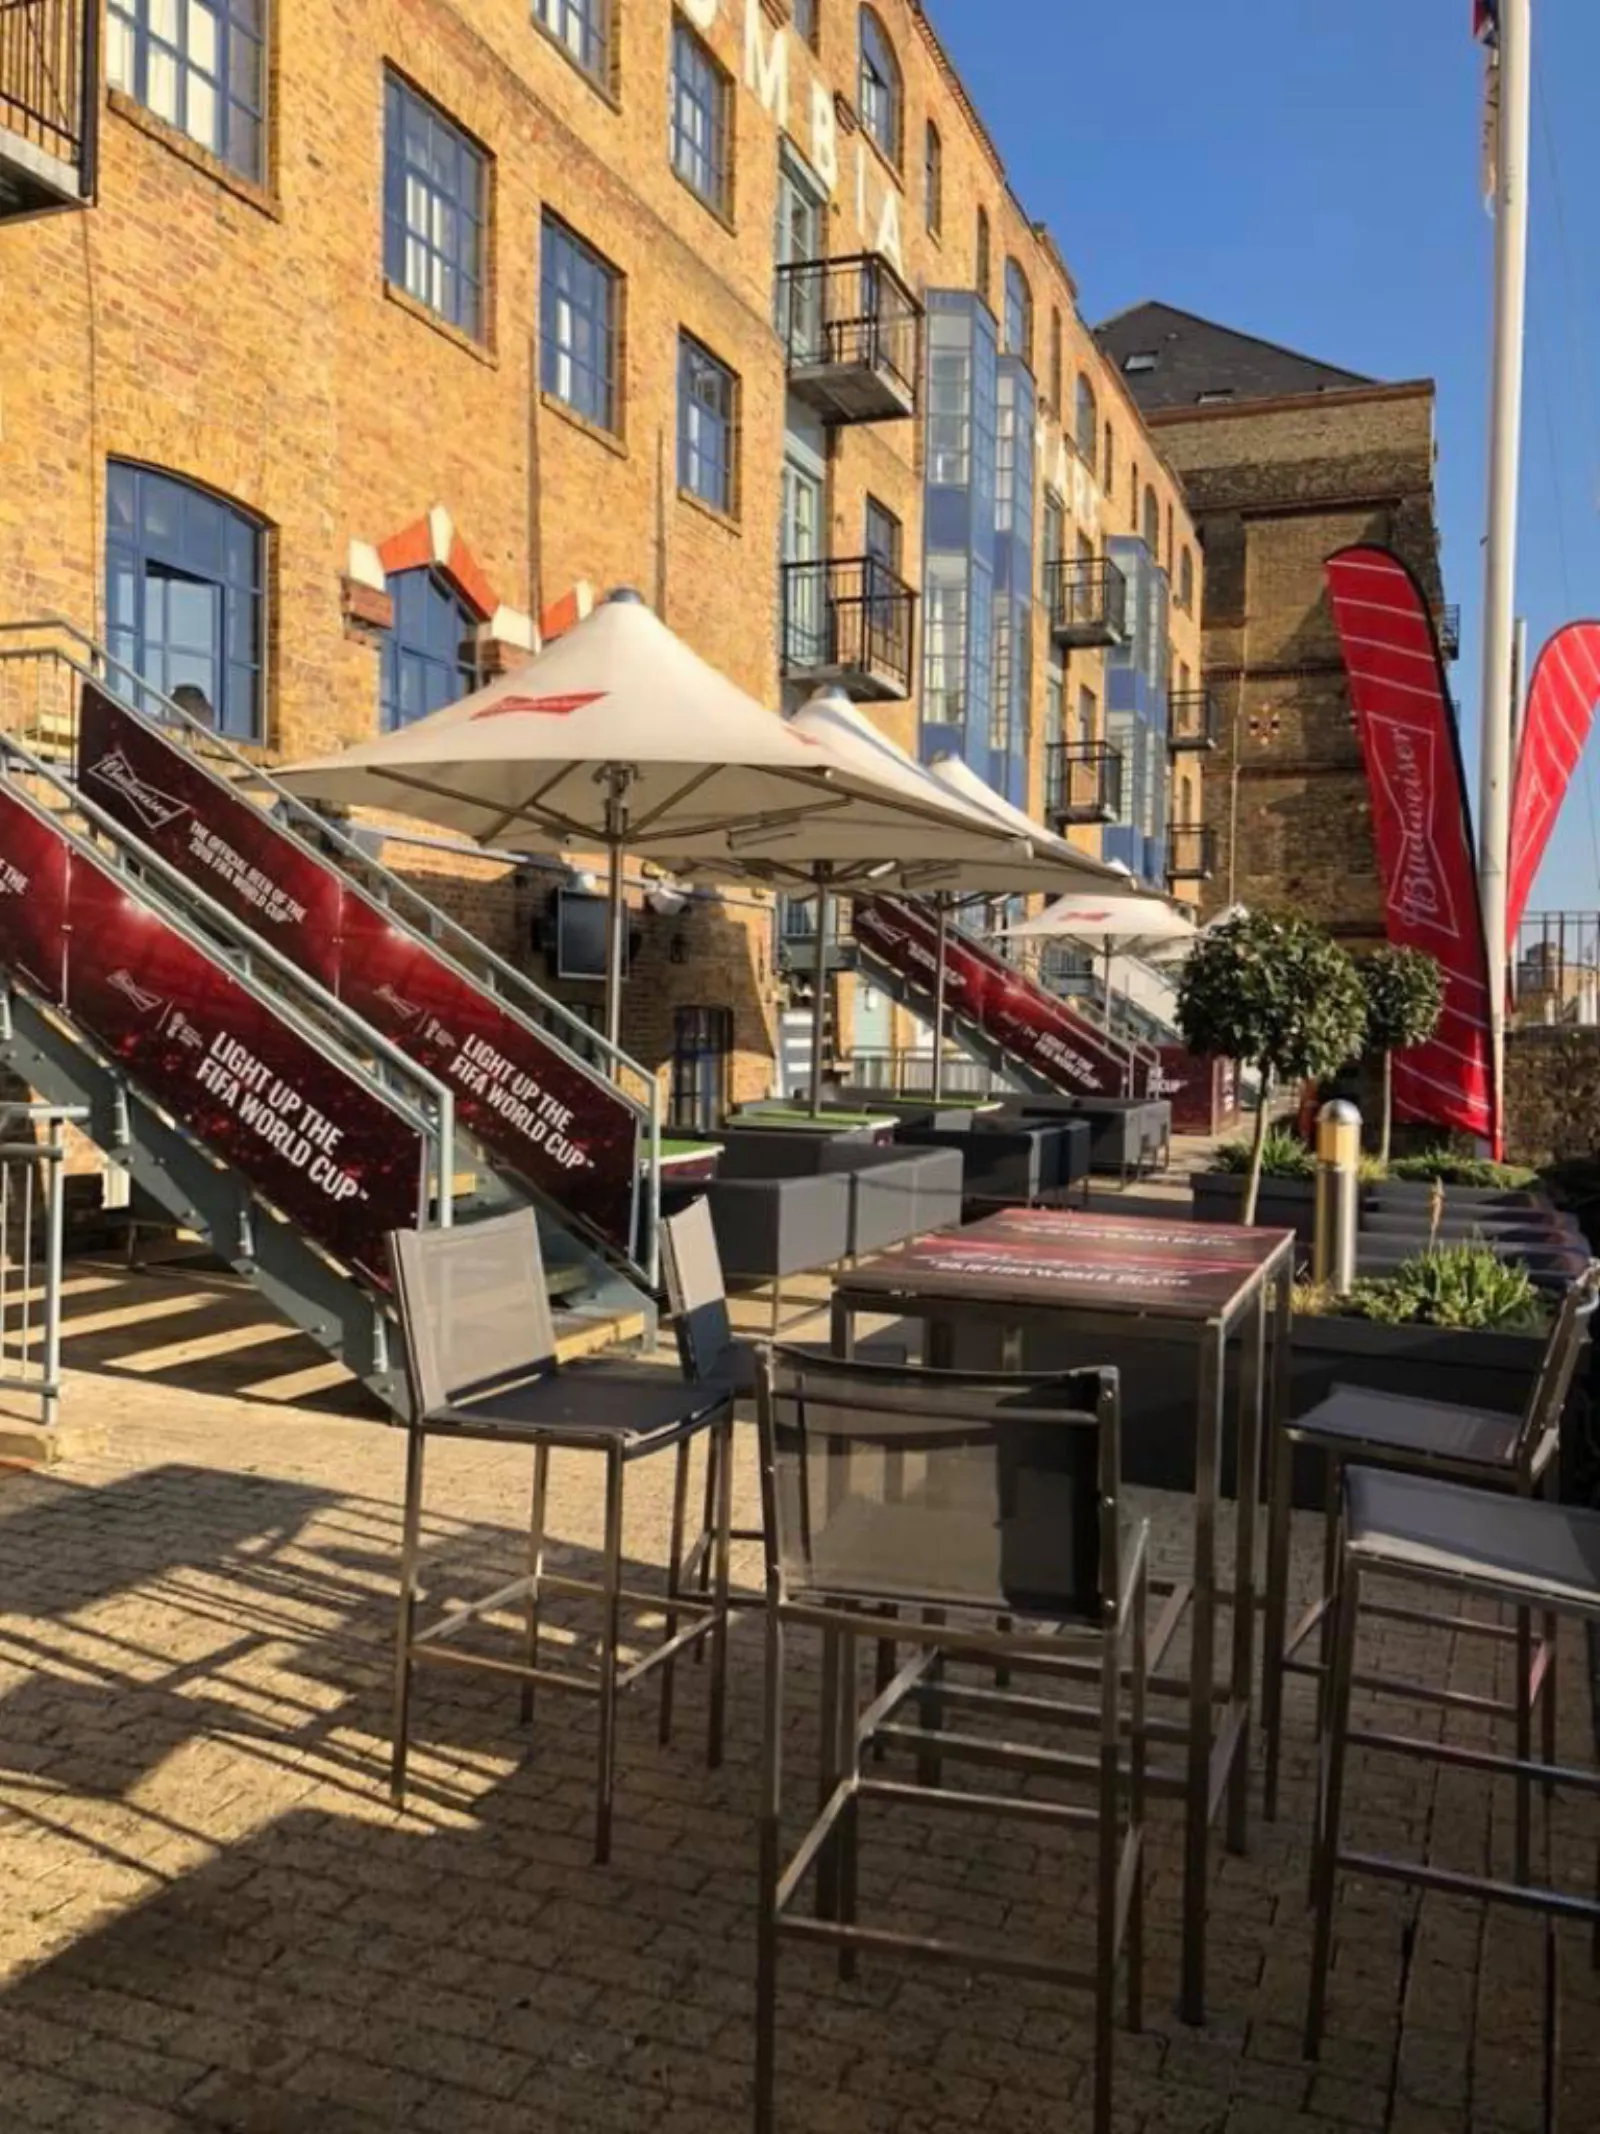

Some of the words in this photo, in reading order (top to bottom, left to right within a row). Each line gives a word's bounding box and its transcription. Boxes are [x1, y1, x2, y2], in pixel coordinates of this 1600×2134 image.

[1391, 725, 1441, 927] Budweiser
[196, 1058, 239, 1109] FIFA
[238, 1093, 312, 1167] WORLD
[209, 1031, 273, 1092] LIGHT
[268, 1080, 301, 1115] UP
[299, 1104, 345, 1156] THE
[448, 1055, 488, 1096] FIFA
[486, 1084, 548, 1142] WORLD
[461, 1033, 517, 1085] LIGHT
[510, 1073, 540, 1104] UP
[536, 1093, 575, 1132] THE
